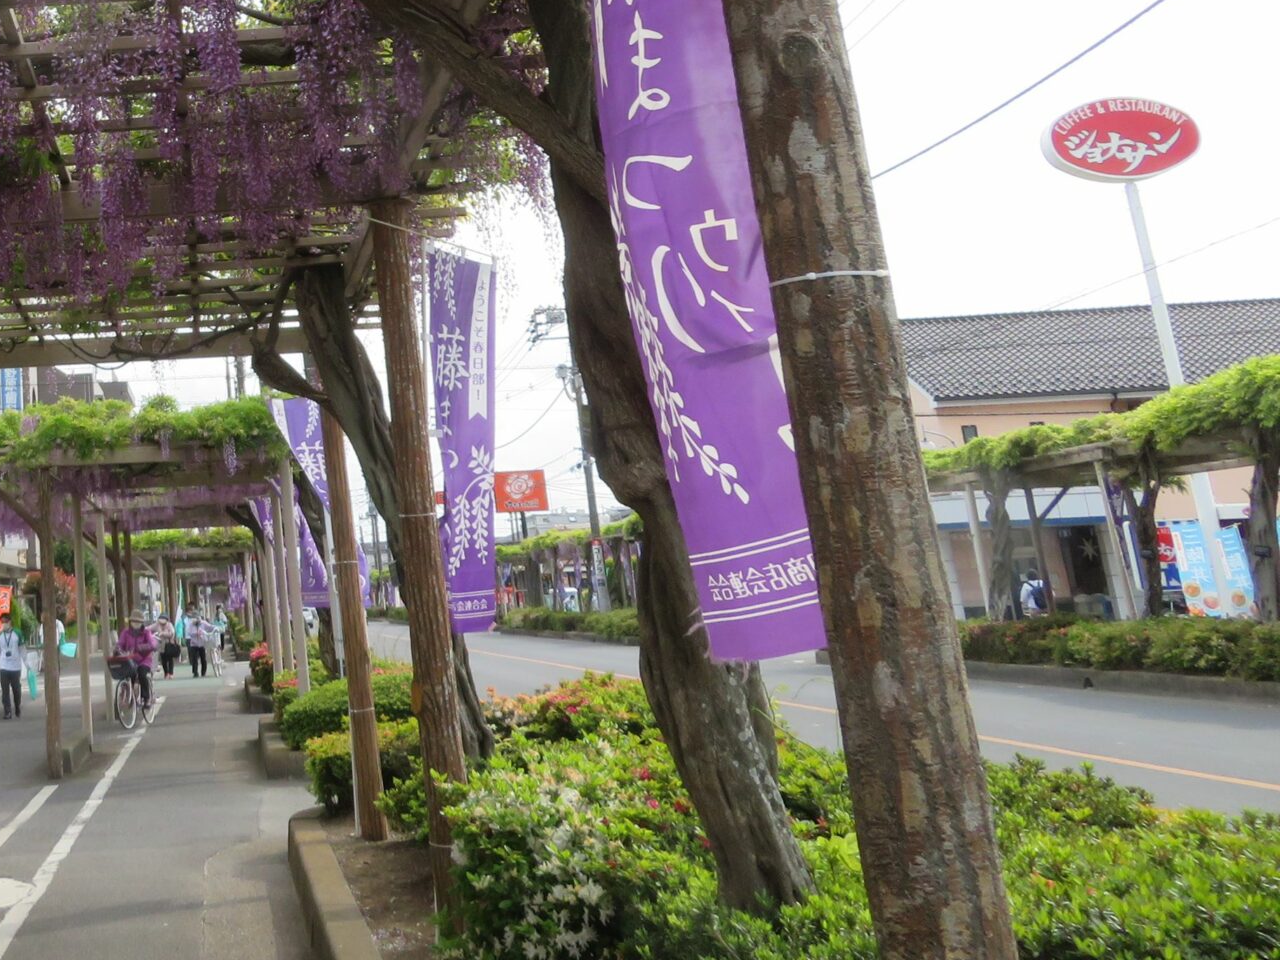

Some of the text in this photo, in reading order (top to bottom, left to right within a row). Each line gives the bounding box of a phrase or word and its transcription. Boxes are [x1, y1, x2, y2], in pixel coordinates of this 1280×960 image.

[1054, 99, 1187, 135] COFFEE & RESTAURANT
[1064, 128, 1182, 173] ジョナサン
